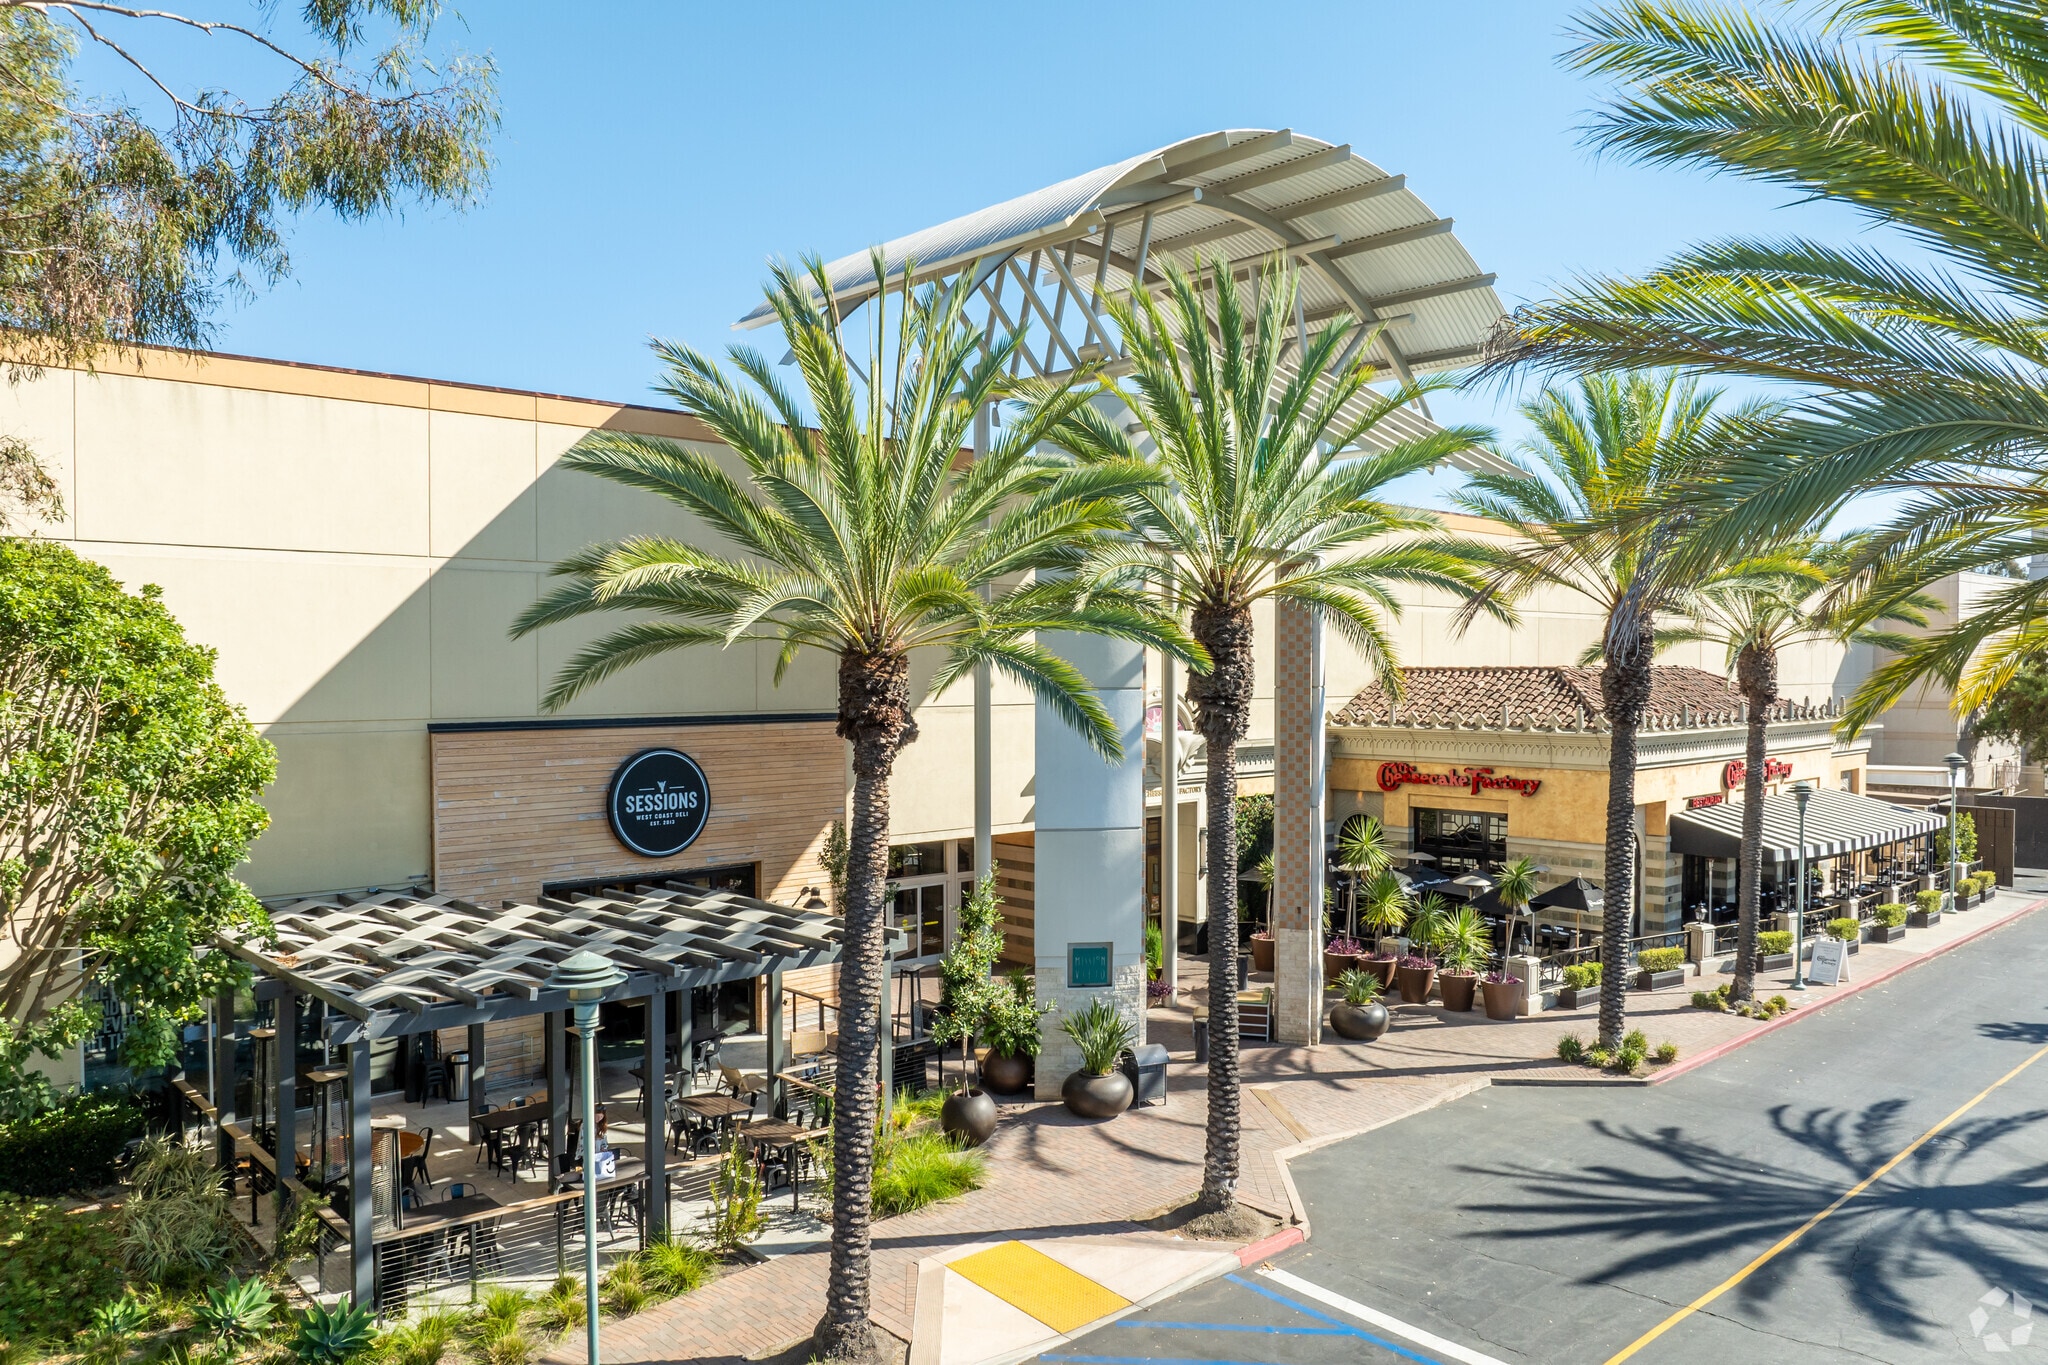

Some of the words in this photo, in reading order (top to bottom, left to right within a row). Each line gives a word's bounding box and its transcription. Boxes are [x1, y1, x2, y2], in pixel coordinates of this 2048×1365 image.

[1377, 763, 1470, 791] Cheesecake
[1464, 768, 1541, 797] Factory
[625, 791, 698, 813] SESSIONS
[103, 1013, 138, 1034] EVER
